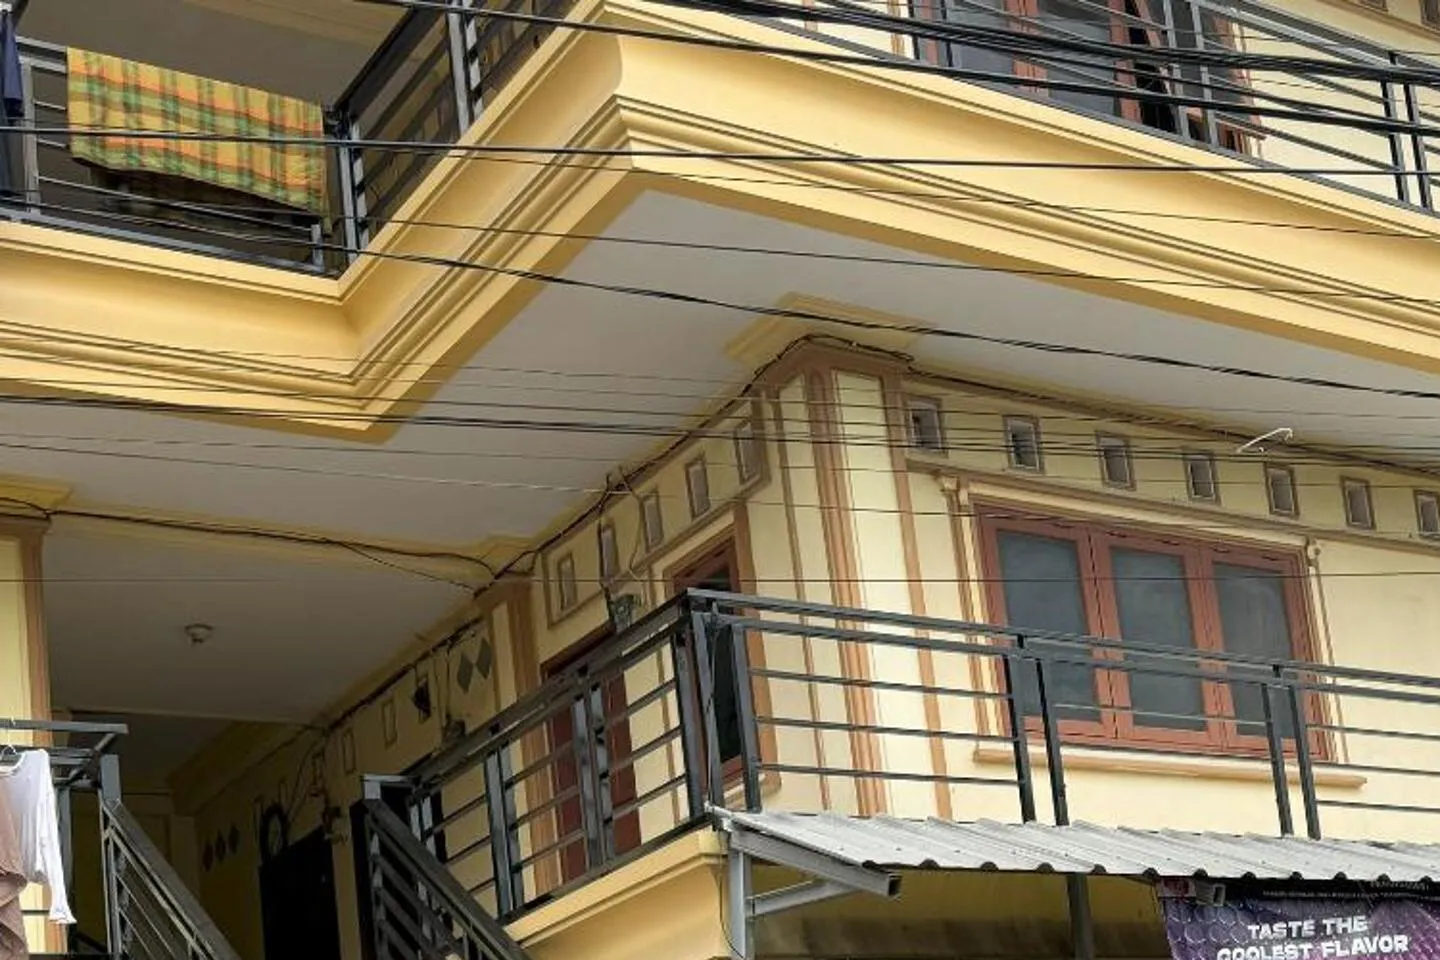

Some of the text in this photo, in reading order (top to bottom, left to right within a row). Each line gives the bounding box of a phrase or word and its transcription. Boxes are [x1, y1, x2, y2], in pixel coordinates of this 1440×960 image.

[1248, 915, 1369, 940] TASTE THE
[1321, 934, 1410, 958] FLAVOR
